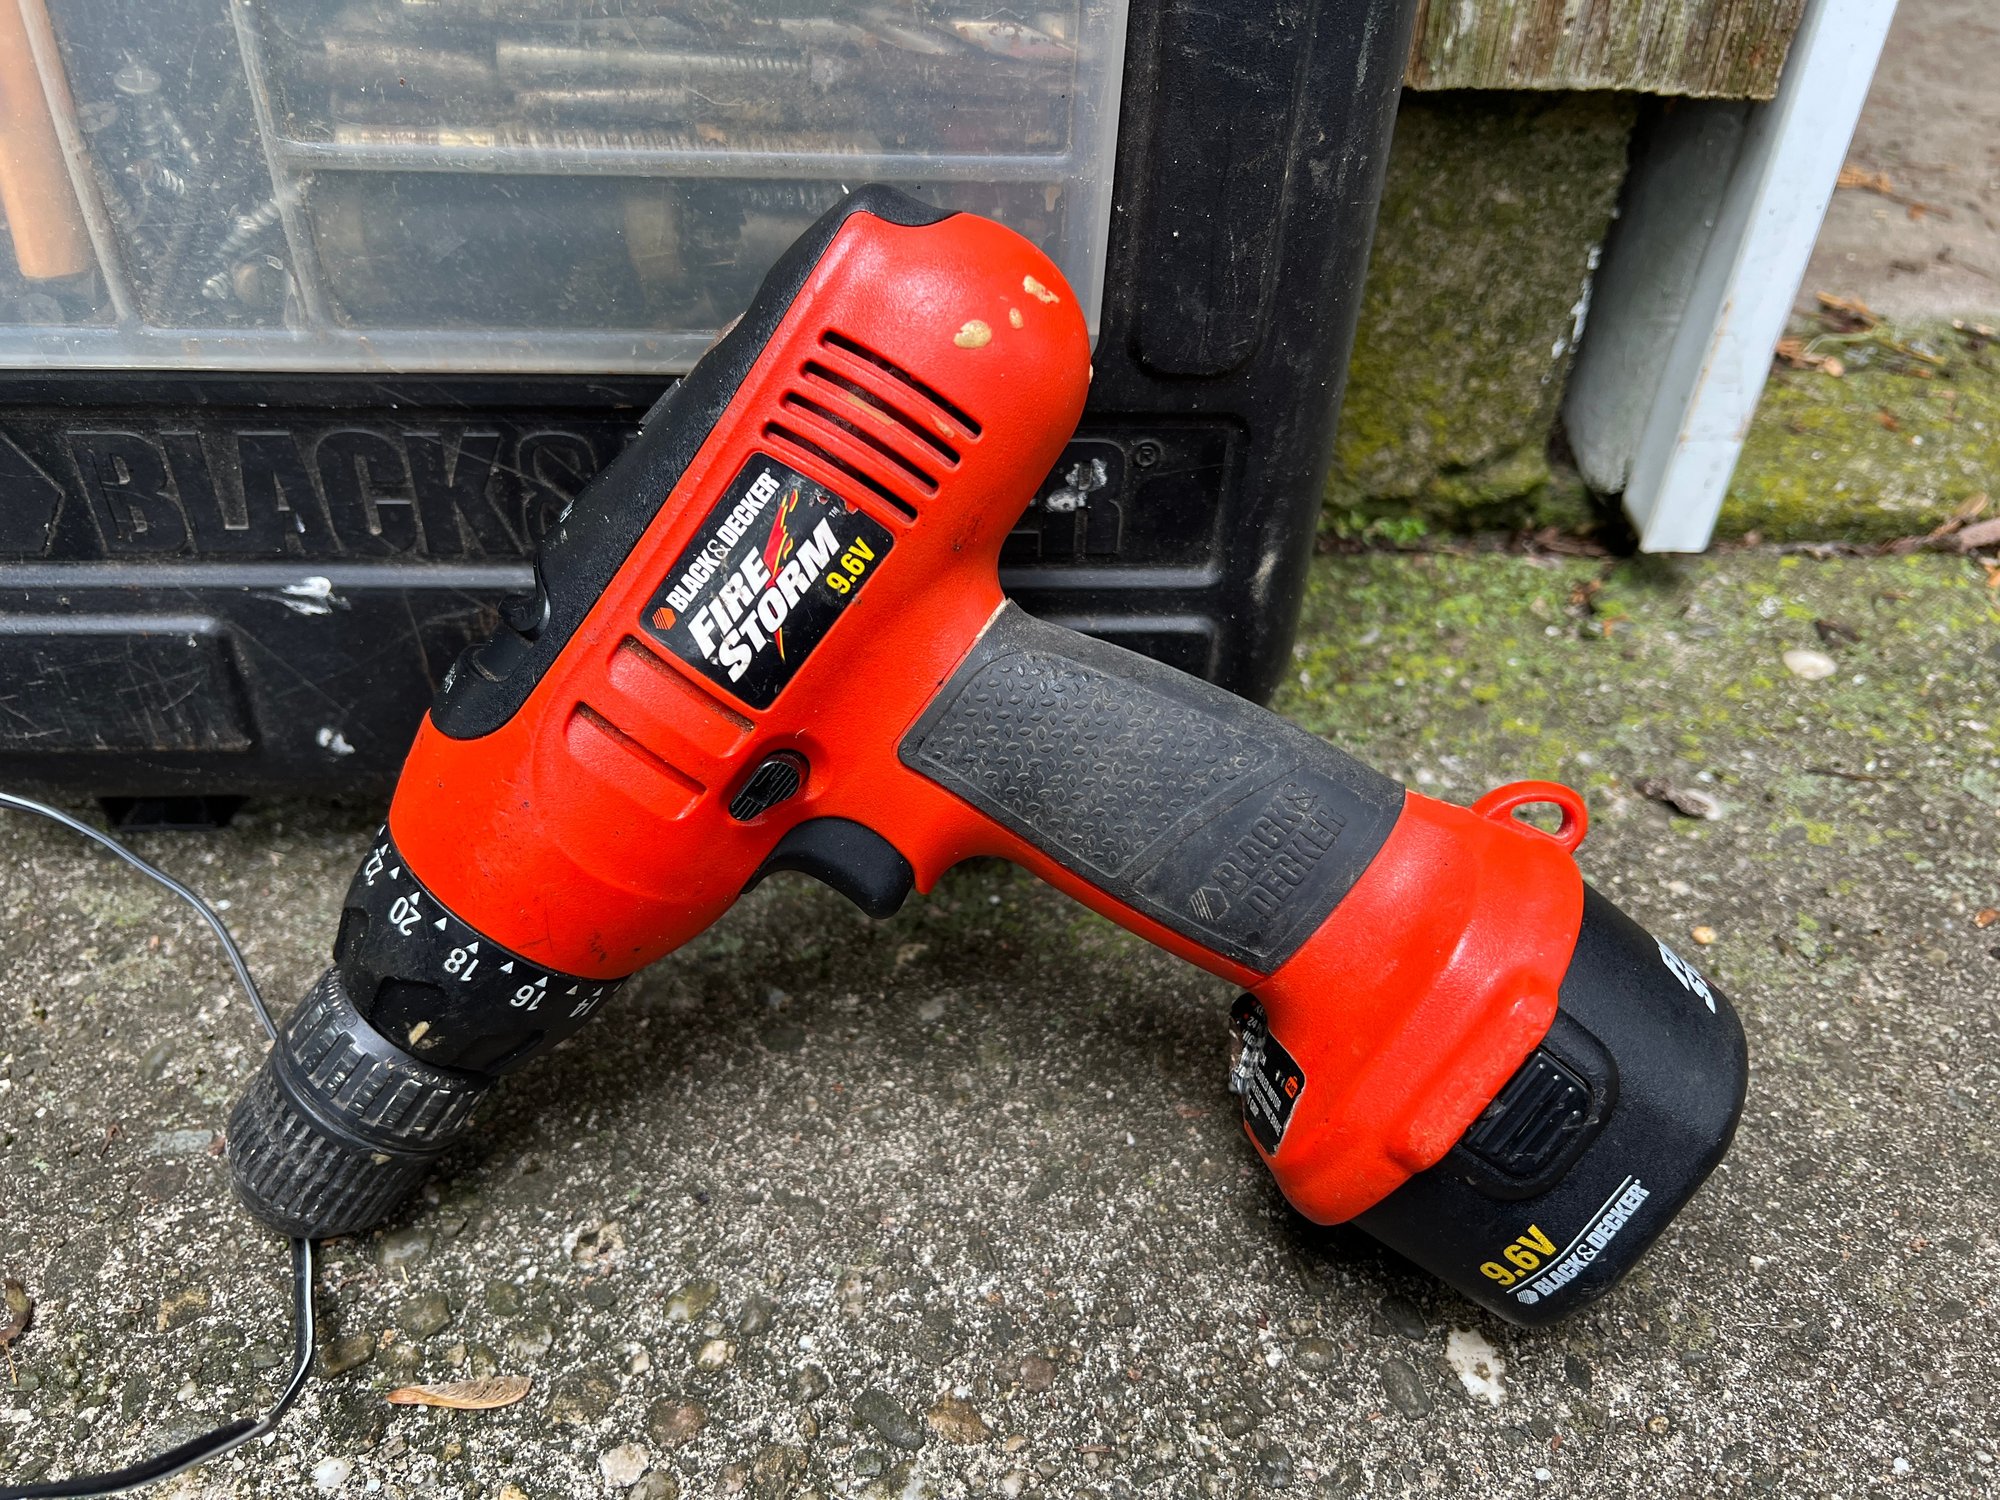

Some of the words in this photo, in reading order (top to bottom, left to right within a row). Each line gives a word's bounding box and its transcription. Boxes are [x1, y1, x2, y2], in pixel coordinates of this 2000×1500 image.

[826, 536, 875, 594] 9.6V
[687, 546, 772, 660] FIRE
[718, 517, 841, 683] STORM
[1246, 803, 1347, 919] DECKER
[388, 896, 422, 936] 20
[443, 948, 479, 982] 18
[510, 985, 546, 1011] 16
[569, 998, 600, 1018] 14
[1479, 1223, 1557, 1286] 9.6V
